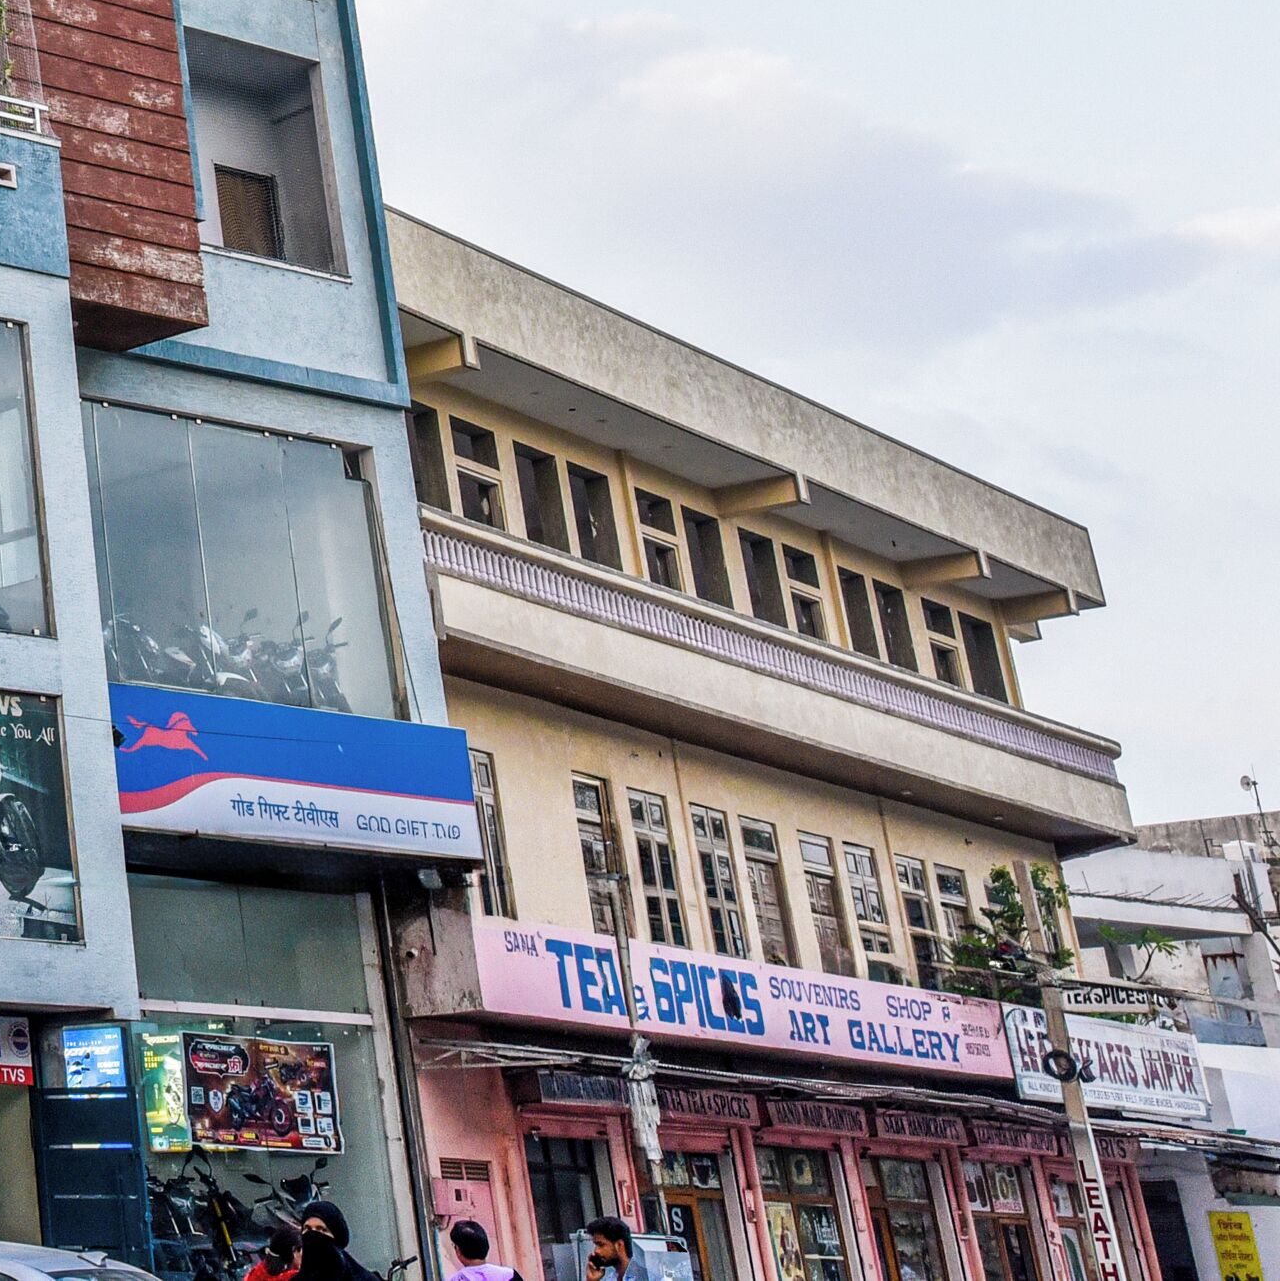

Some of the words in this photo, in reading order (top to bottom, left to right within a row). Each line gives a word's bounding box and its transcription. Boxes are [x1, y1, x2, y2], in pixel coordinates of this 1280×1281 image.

[10, 723, 32, 740] You
[36, 727, 55, 747] All
[230, 793, 255, 817] गोड
[258, 796, 290, 821] गिफ्ट
[292, 800, 339, 829] टीवीएस
[356, 814, 391, 834] GOD
[395, 818, 428, 839] GIFT
[545, 938, 628, 1017] TEA
[649, 956, 766, 1036] SPICES
[769, 975, 861, 1012] SOUVENIRS
[886, 994, 932, 1022] SHOP
[788, 1009, 831, 1046] ART
[847, 1019, 961, 1063] GALLERY
[1, 1067, 26, 1083] TVS
[1094, 1041, 1139, 1088] ARTS
[1140, 1047, 1199, 1096] JAIPUR
[713, 1094, 751, 1119] SPICES
